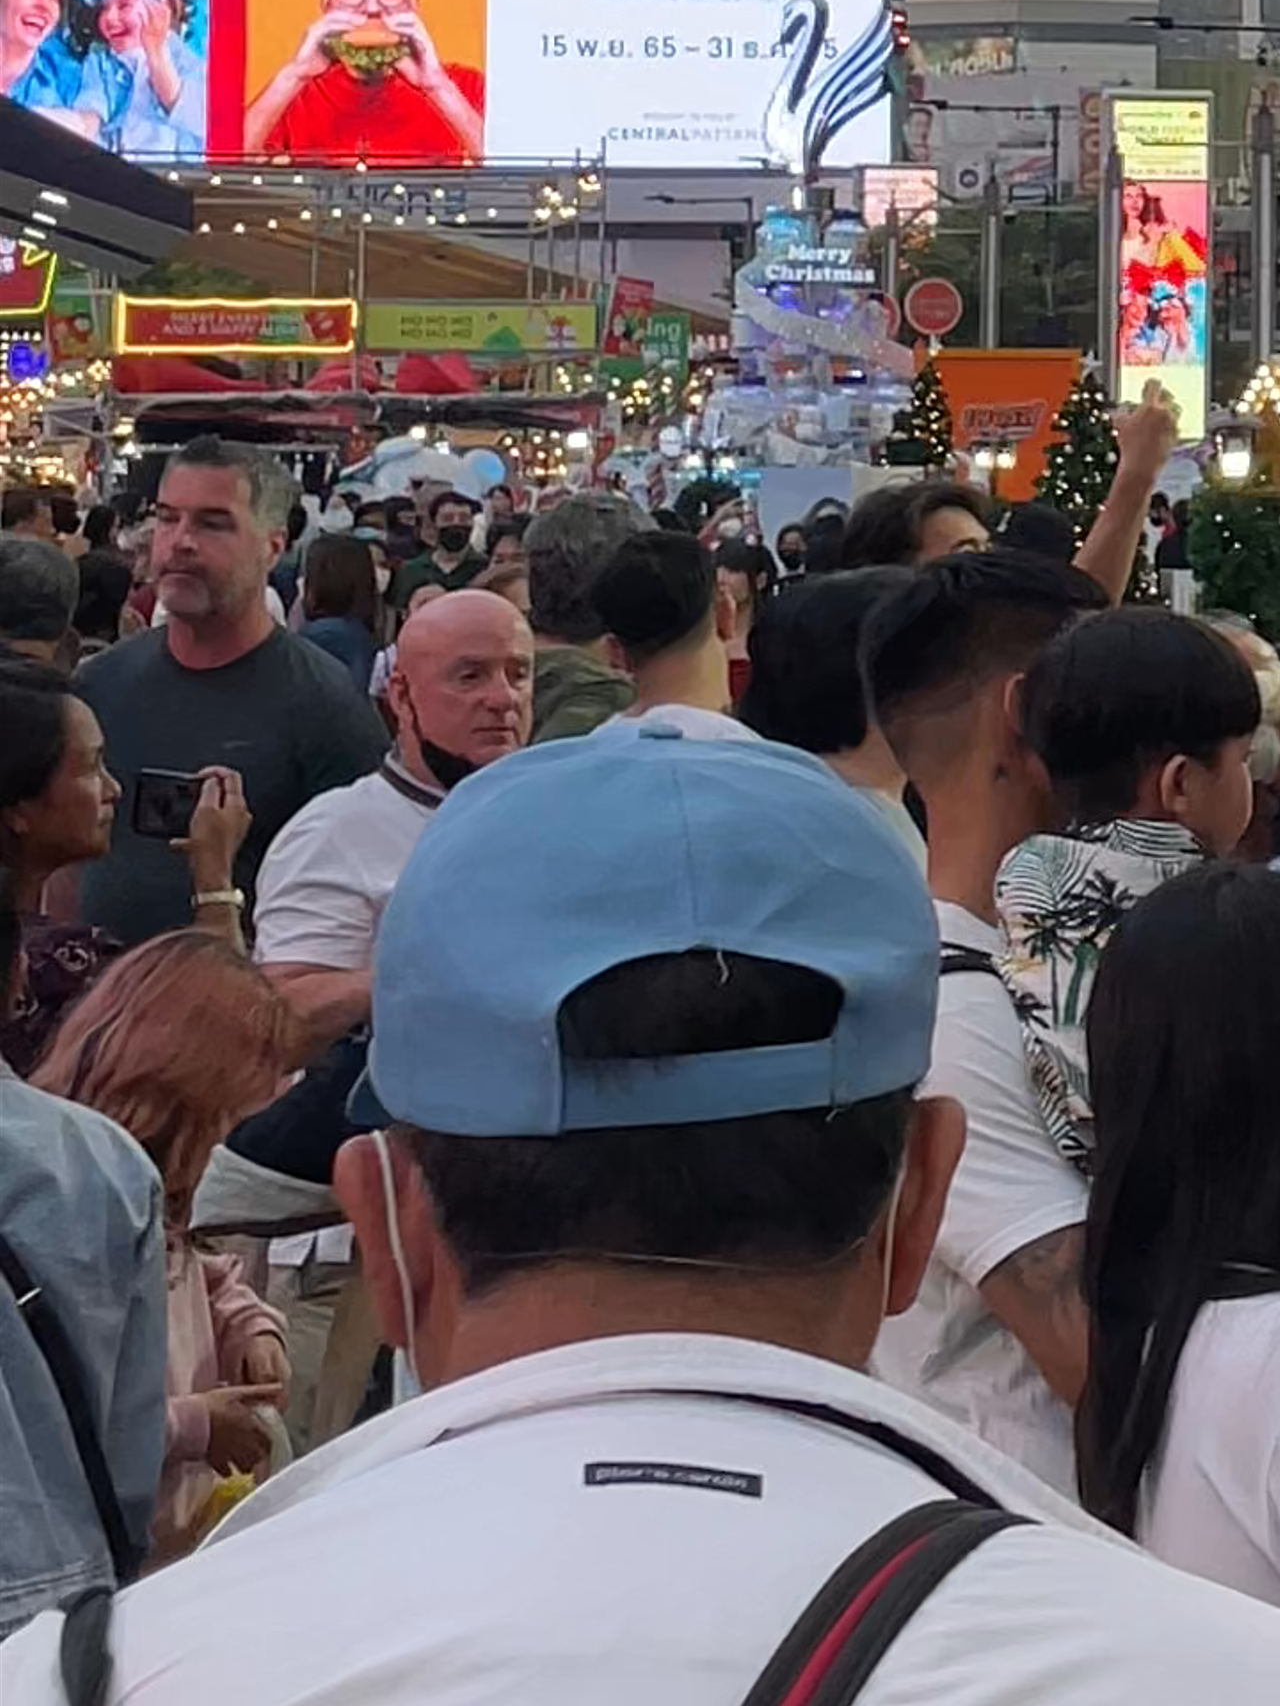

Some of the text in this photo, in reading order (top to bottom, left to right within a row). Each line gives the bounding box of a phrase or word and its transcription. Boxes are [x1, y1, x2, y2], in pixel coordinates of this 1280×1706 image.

[541, 33, 568, 58] 15
[643, 35, 677, 59] 65
[707, 35, 733, 59] 31
[788, 245, 851, 264] Merry
[765, 263, 875, 283] Christmas
